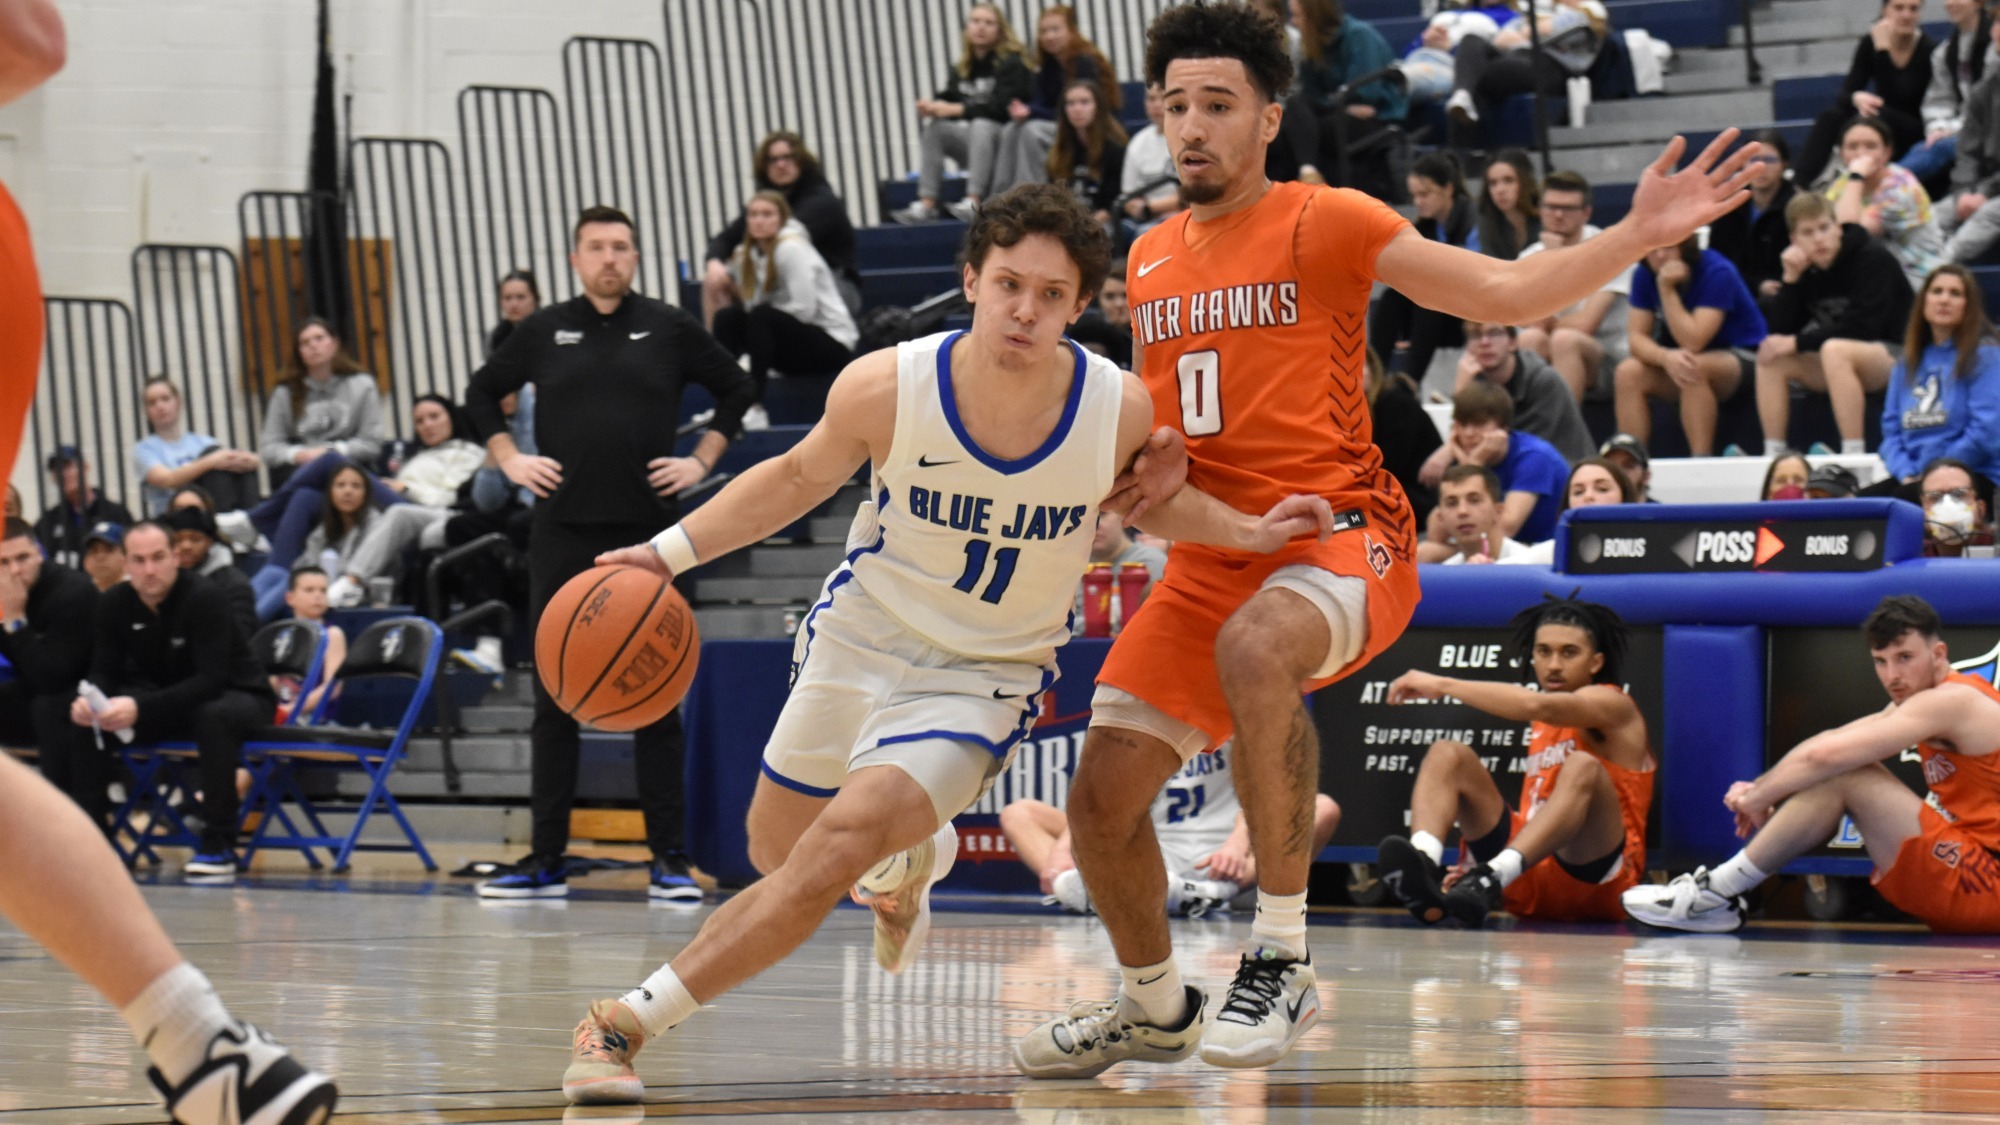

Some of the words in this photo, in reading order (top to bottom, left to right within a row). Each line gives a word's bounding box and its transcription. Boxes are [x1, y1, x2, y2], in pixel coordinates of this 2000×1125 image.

[1133, 295, 1182, 346] IVER
[1190, 281, 1298, 335] HAWKS
[1176, 348, 1224, 438] 0
[909, 485, 994, 535] BLUE
[1000, 504, 1087, 541] JAYS
[1350, 514, 1361, 523] M
[1603, 538, 1647, 558] BONUS
[1696, 530, 1756, 563] POSS
[1805, 535, 1849, 556] BONUS
[952, 538, 1022, 605] 11
[655, 604, 684, 651] THE
[612, 642, 669, 695] ROCK
[1439, 645, 1502, 668] BLUE
[1481, 729, 1515, 746] THE
[1365, 755, 1415, 774] PAST,
[1166, 784, 1205, 824] 21
